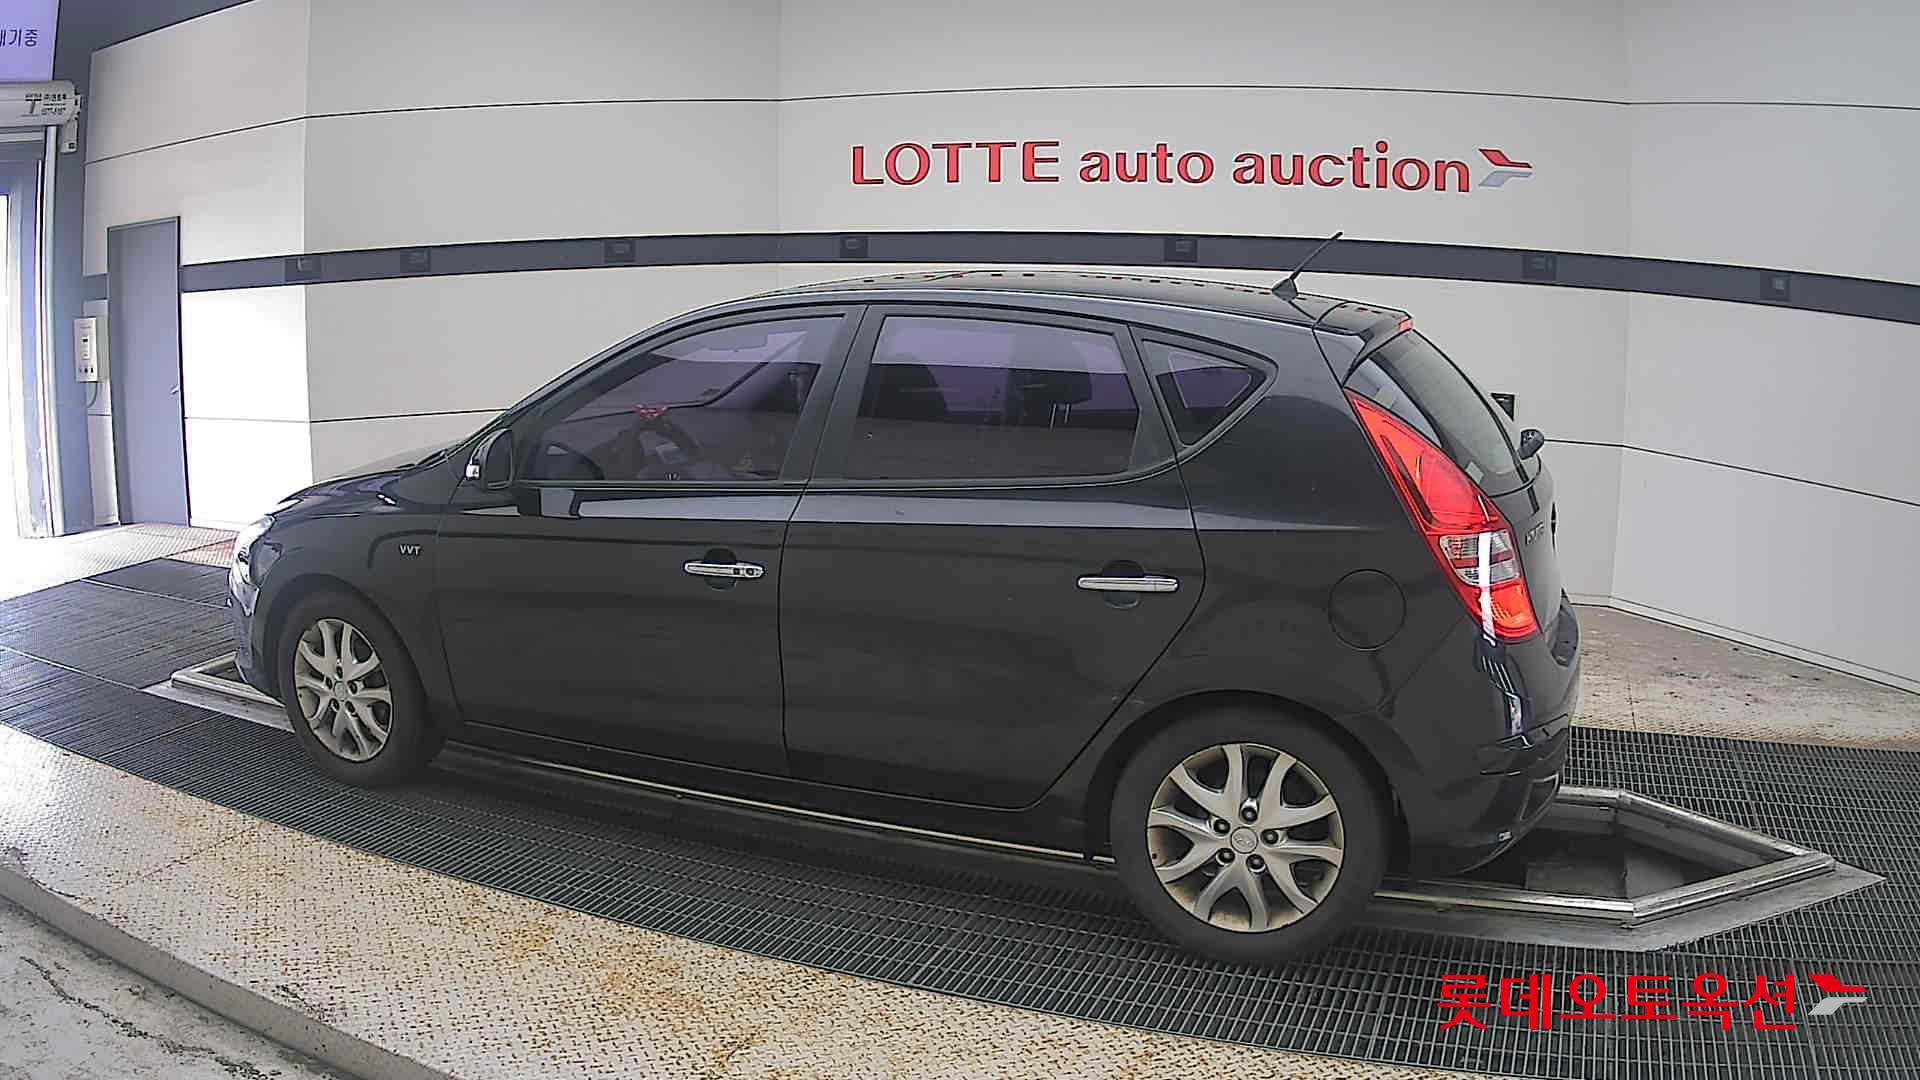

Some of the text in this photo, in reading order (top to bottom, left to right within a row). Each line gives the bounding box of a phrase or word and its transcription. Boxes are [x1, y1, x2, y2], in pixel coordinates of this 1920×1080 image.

[851, 140, 1470, 193] LOTTE auto auction
[399, 544, 421, 556] VVT
